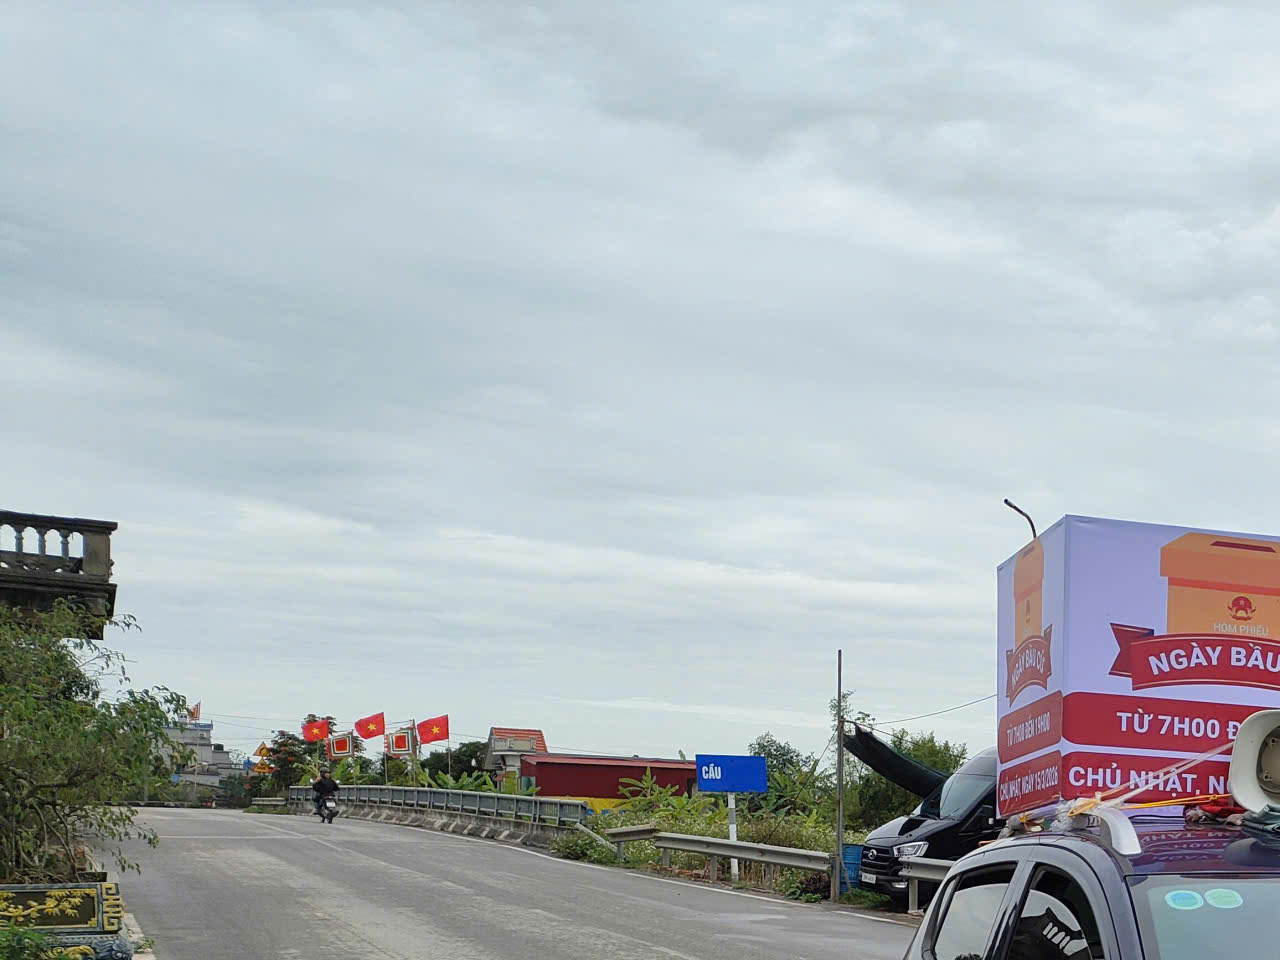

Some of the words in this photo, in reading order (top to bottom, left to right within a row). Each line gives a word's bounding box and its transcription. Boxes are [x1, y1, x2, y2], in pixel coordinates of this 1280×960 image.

[1148, 642, 1222, 676] NGÀY
[1116, 708, 1154, 733] TỪ
[1158, 715, 1220, 739] 7H00
[1068, 762, 1122, 789] CHỦ
